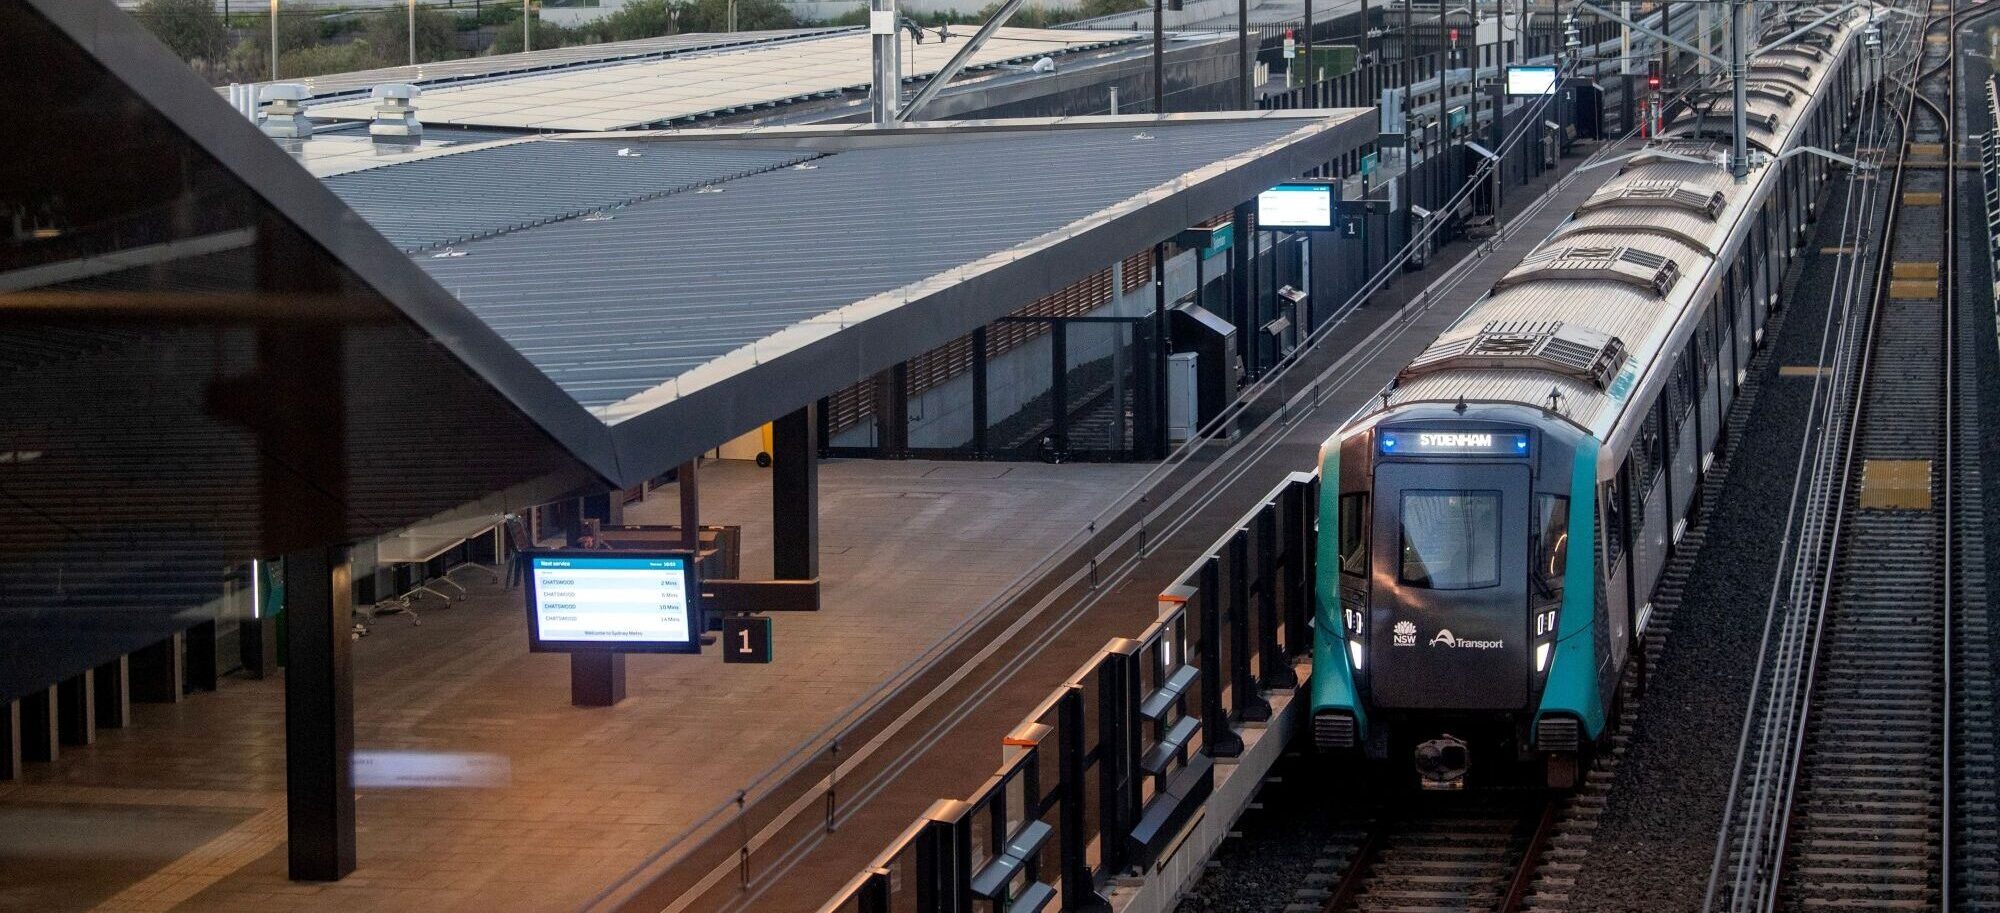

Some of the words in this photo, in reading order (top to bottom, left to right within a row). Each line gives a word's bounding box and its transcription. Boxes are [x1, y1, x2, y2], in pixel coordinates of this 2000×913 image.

[1565, 90, 1571, 100] 1
[1348, 221, 1356, 235] 1
[1420, 433, 1492, 447] SYDENHAM
[739, 629, 752, 653] 1
[1393, 635, 1417, 644] NSW
[1456, 638, 1504, 650] Transport
